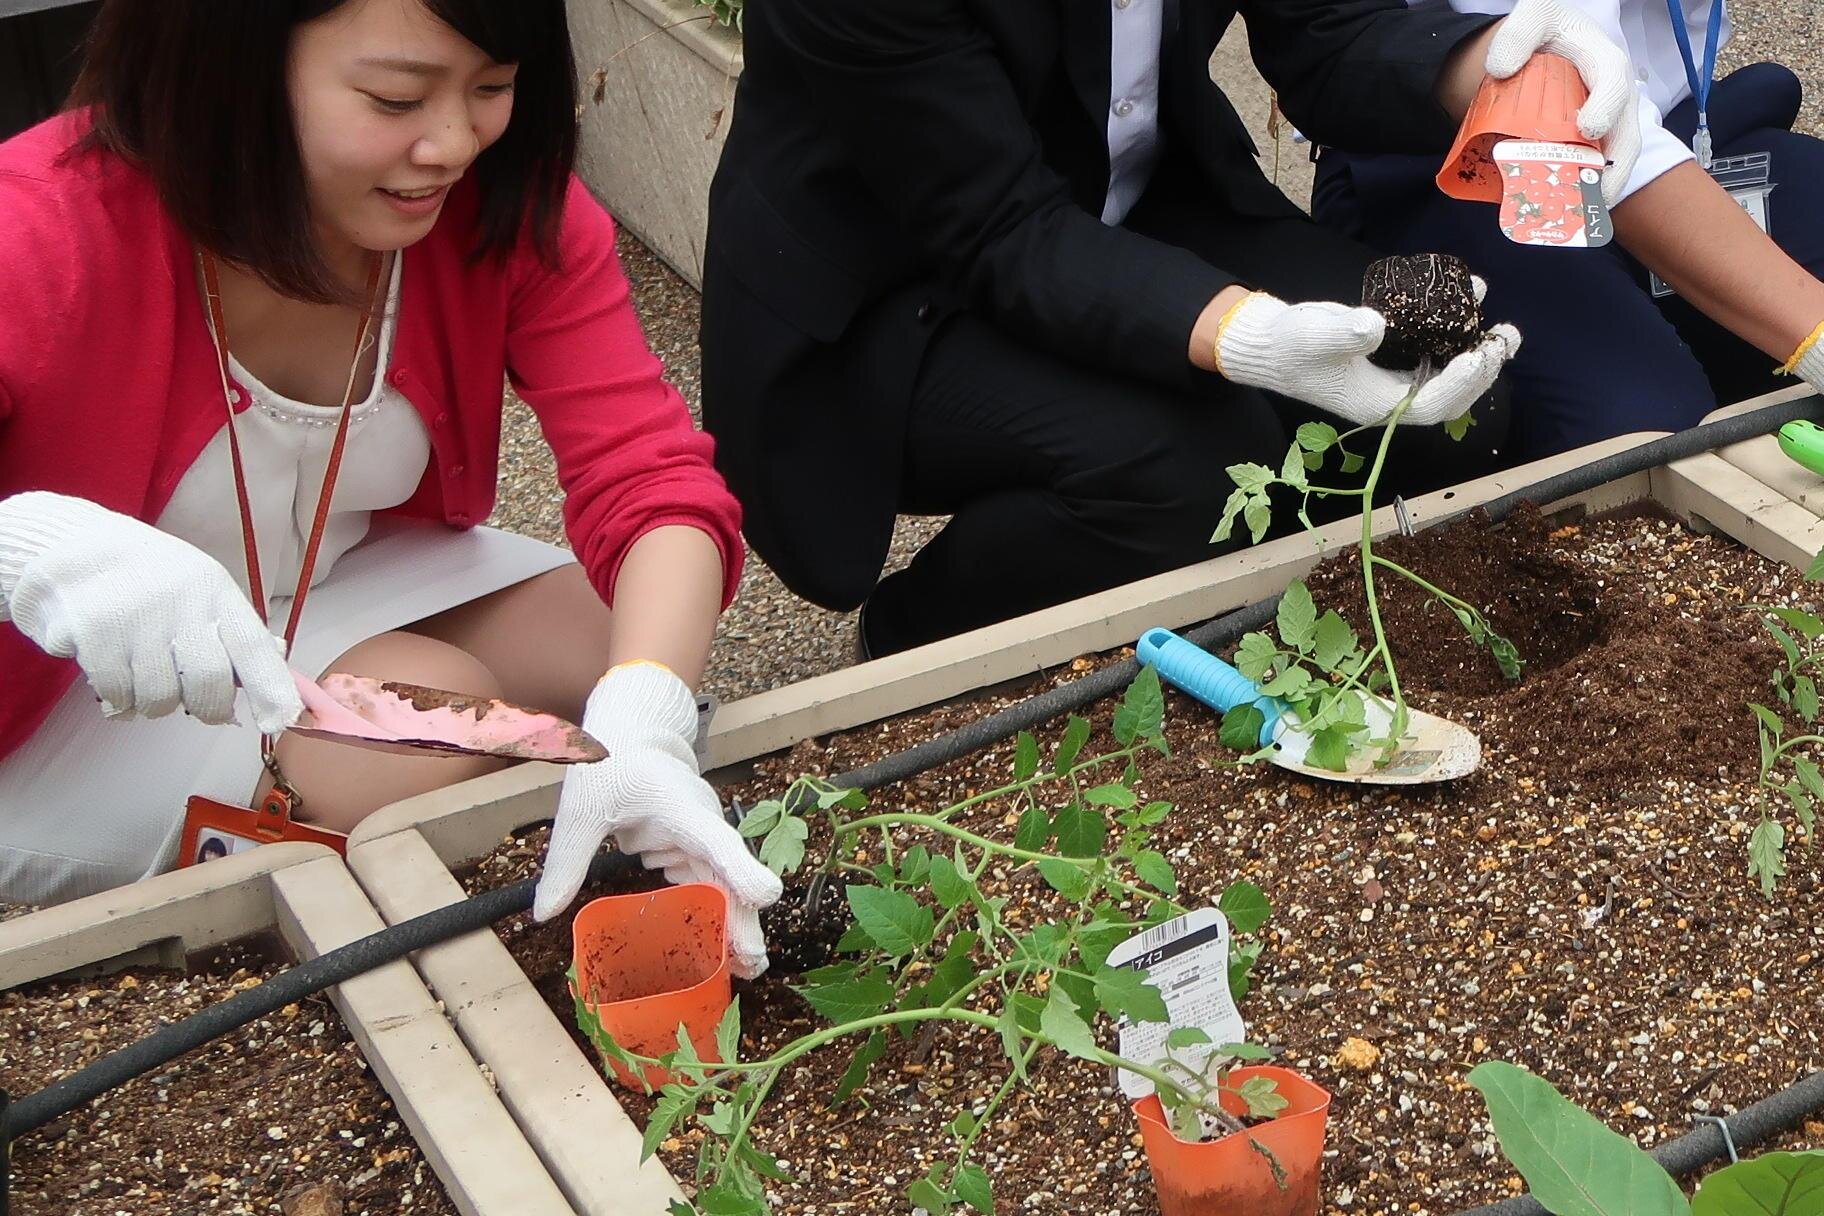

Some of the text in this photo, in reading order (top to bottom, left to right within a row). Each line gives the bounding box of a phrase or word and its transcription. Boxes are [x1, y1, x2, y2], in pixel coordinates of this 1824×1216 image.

[1587, 205, 1603, 237] アイコ
[1135, 950, 1163, 969] アイコ
